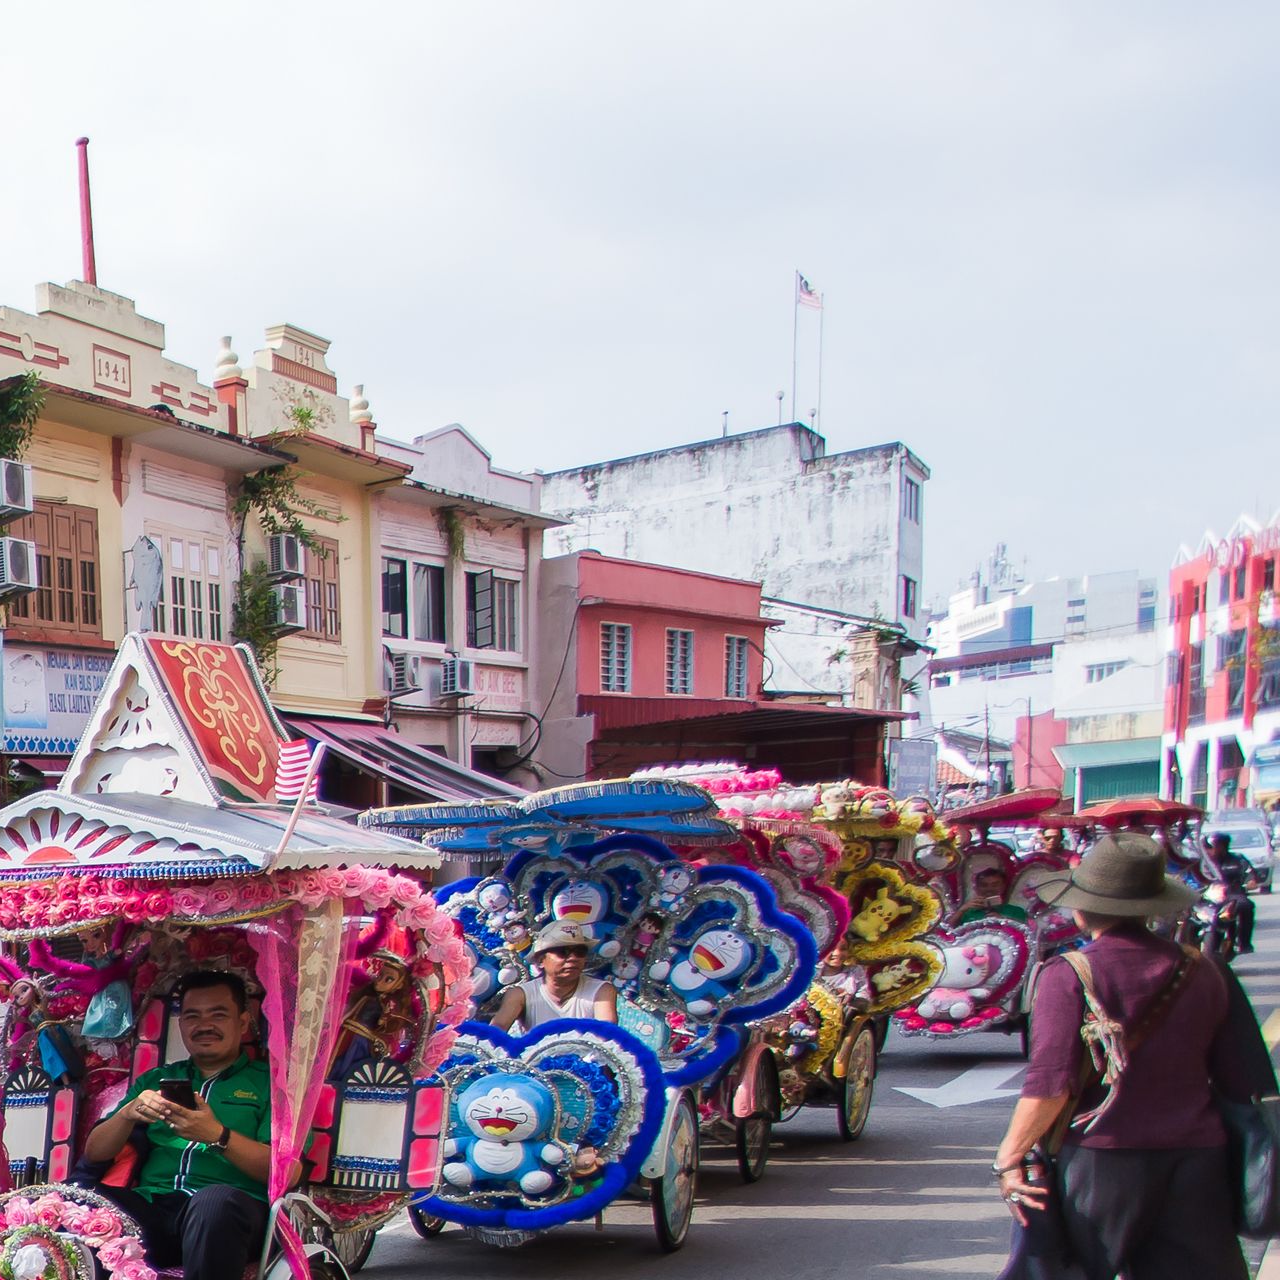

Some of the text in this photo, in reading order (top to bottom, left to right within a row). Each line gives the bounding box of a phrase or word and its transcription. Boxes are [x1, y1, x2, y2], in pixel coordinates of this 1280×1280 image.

[294, 345, 315, 368] 1941
[97, 357, 127, 385] 1941
[64, 672, 78, 691] KAN
[49, 692, 67, 713] HASIL
[68, 694, 91, 714] LAUTAN
